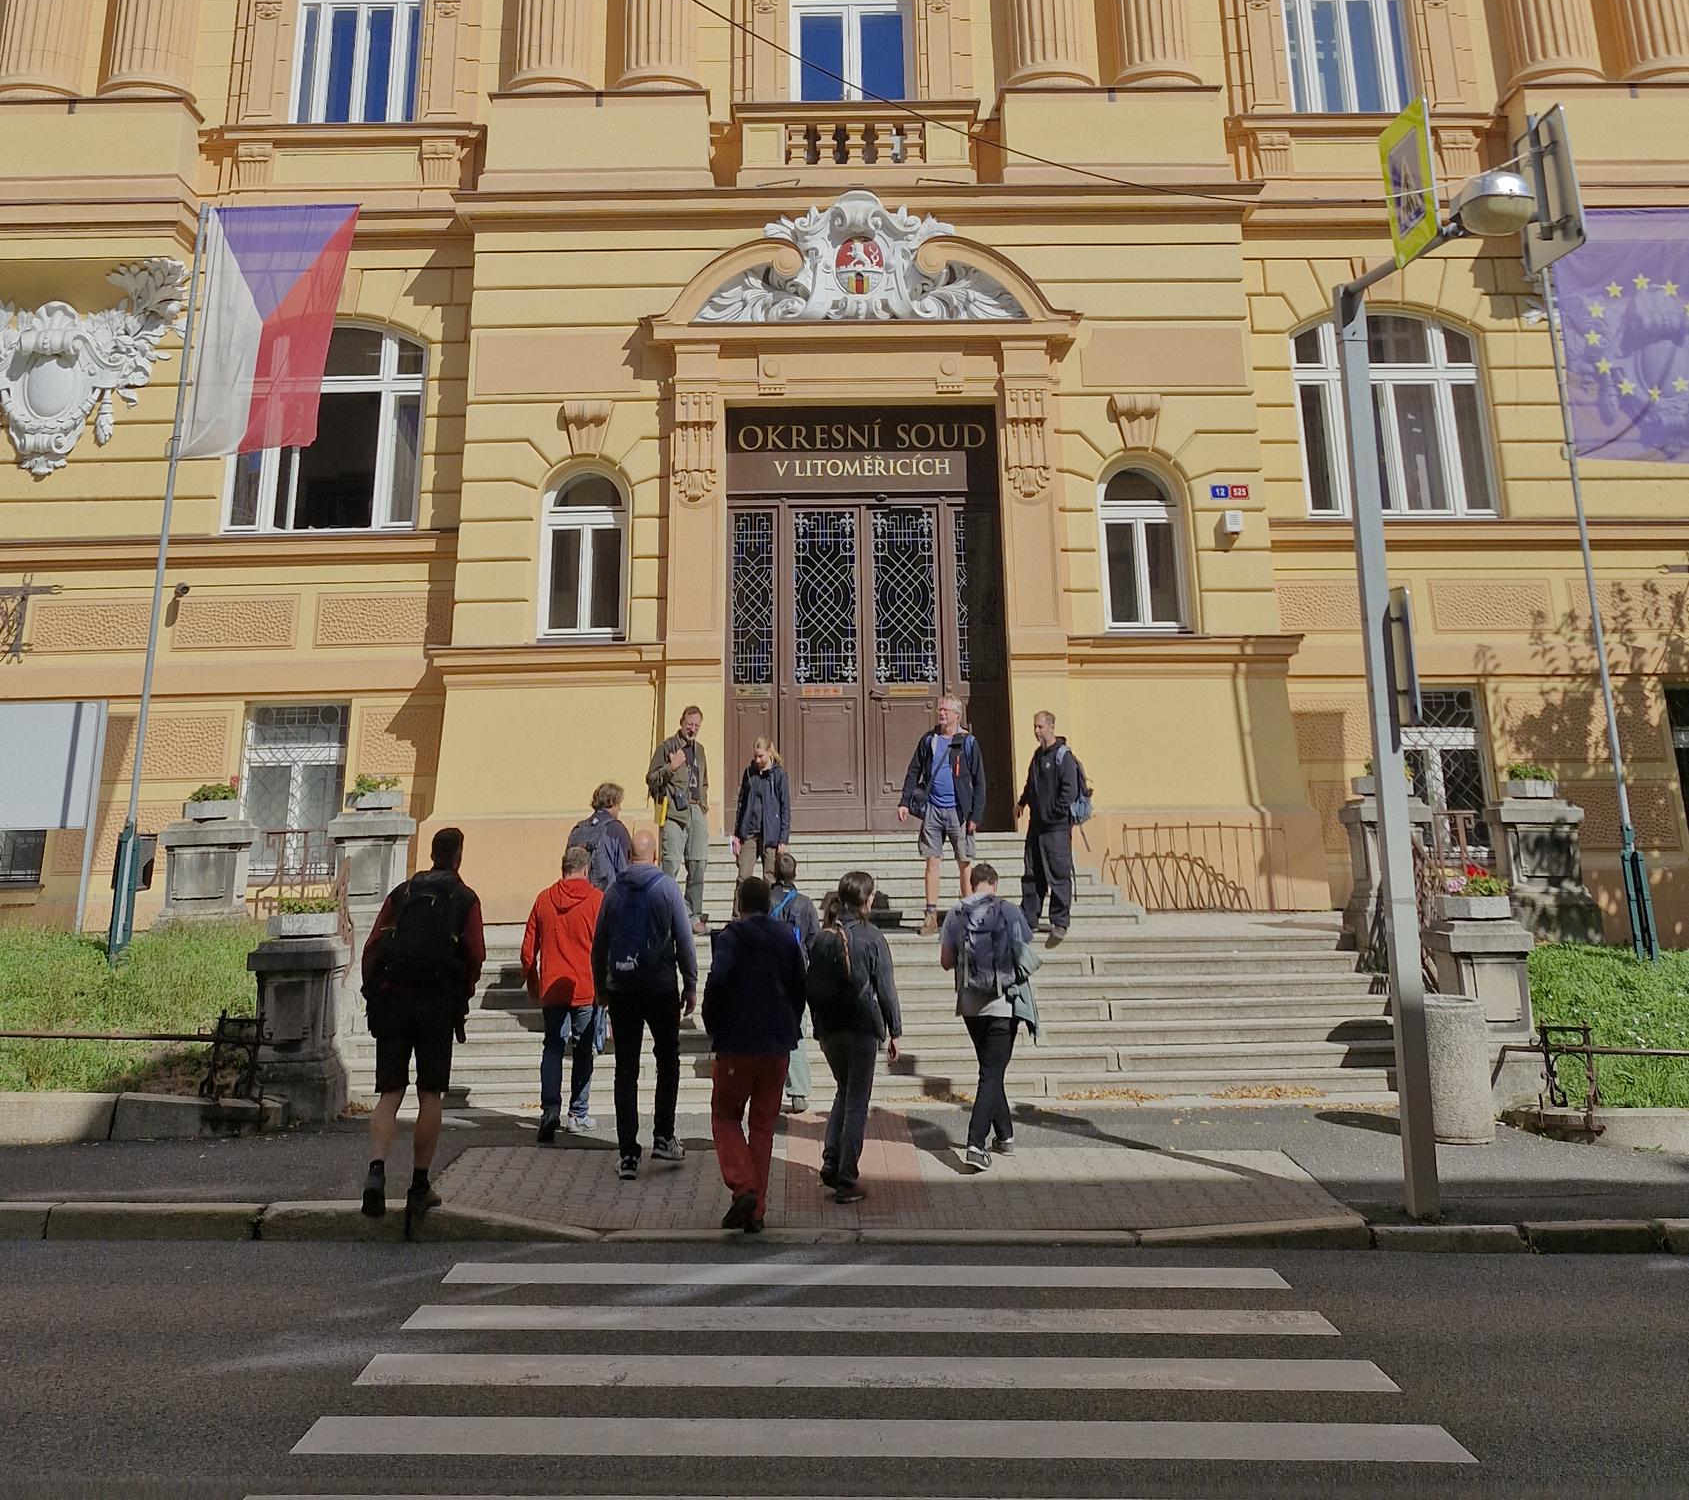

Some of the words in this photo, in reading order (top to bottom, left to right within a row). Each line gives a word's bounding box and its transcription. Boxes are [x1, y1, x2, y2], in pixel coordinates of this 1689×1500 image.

[738, 418, 882, 450] OKRESNÍ
[896, 423, 986, 449] SOUD
[773, 460, 788, 477] V
[794, 453, 951, 477] LITOMĚŘICÍCH
[1216, 487, 1226, 497] 12
[1232, 487, 1247, 497] 525
